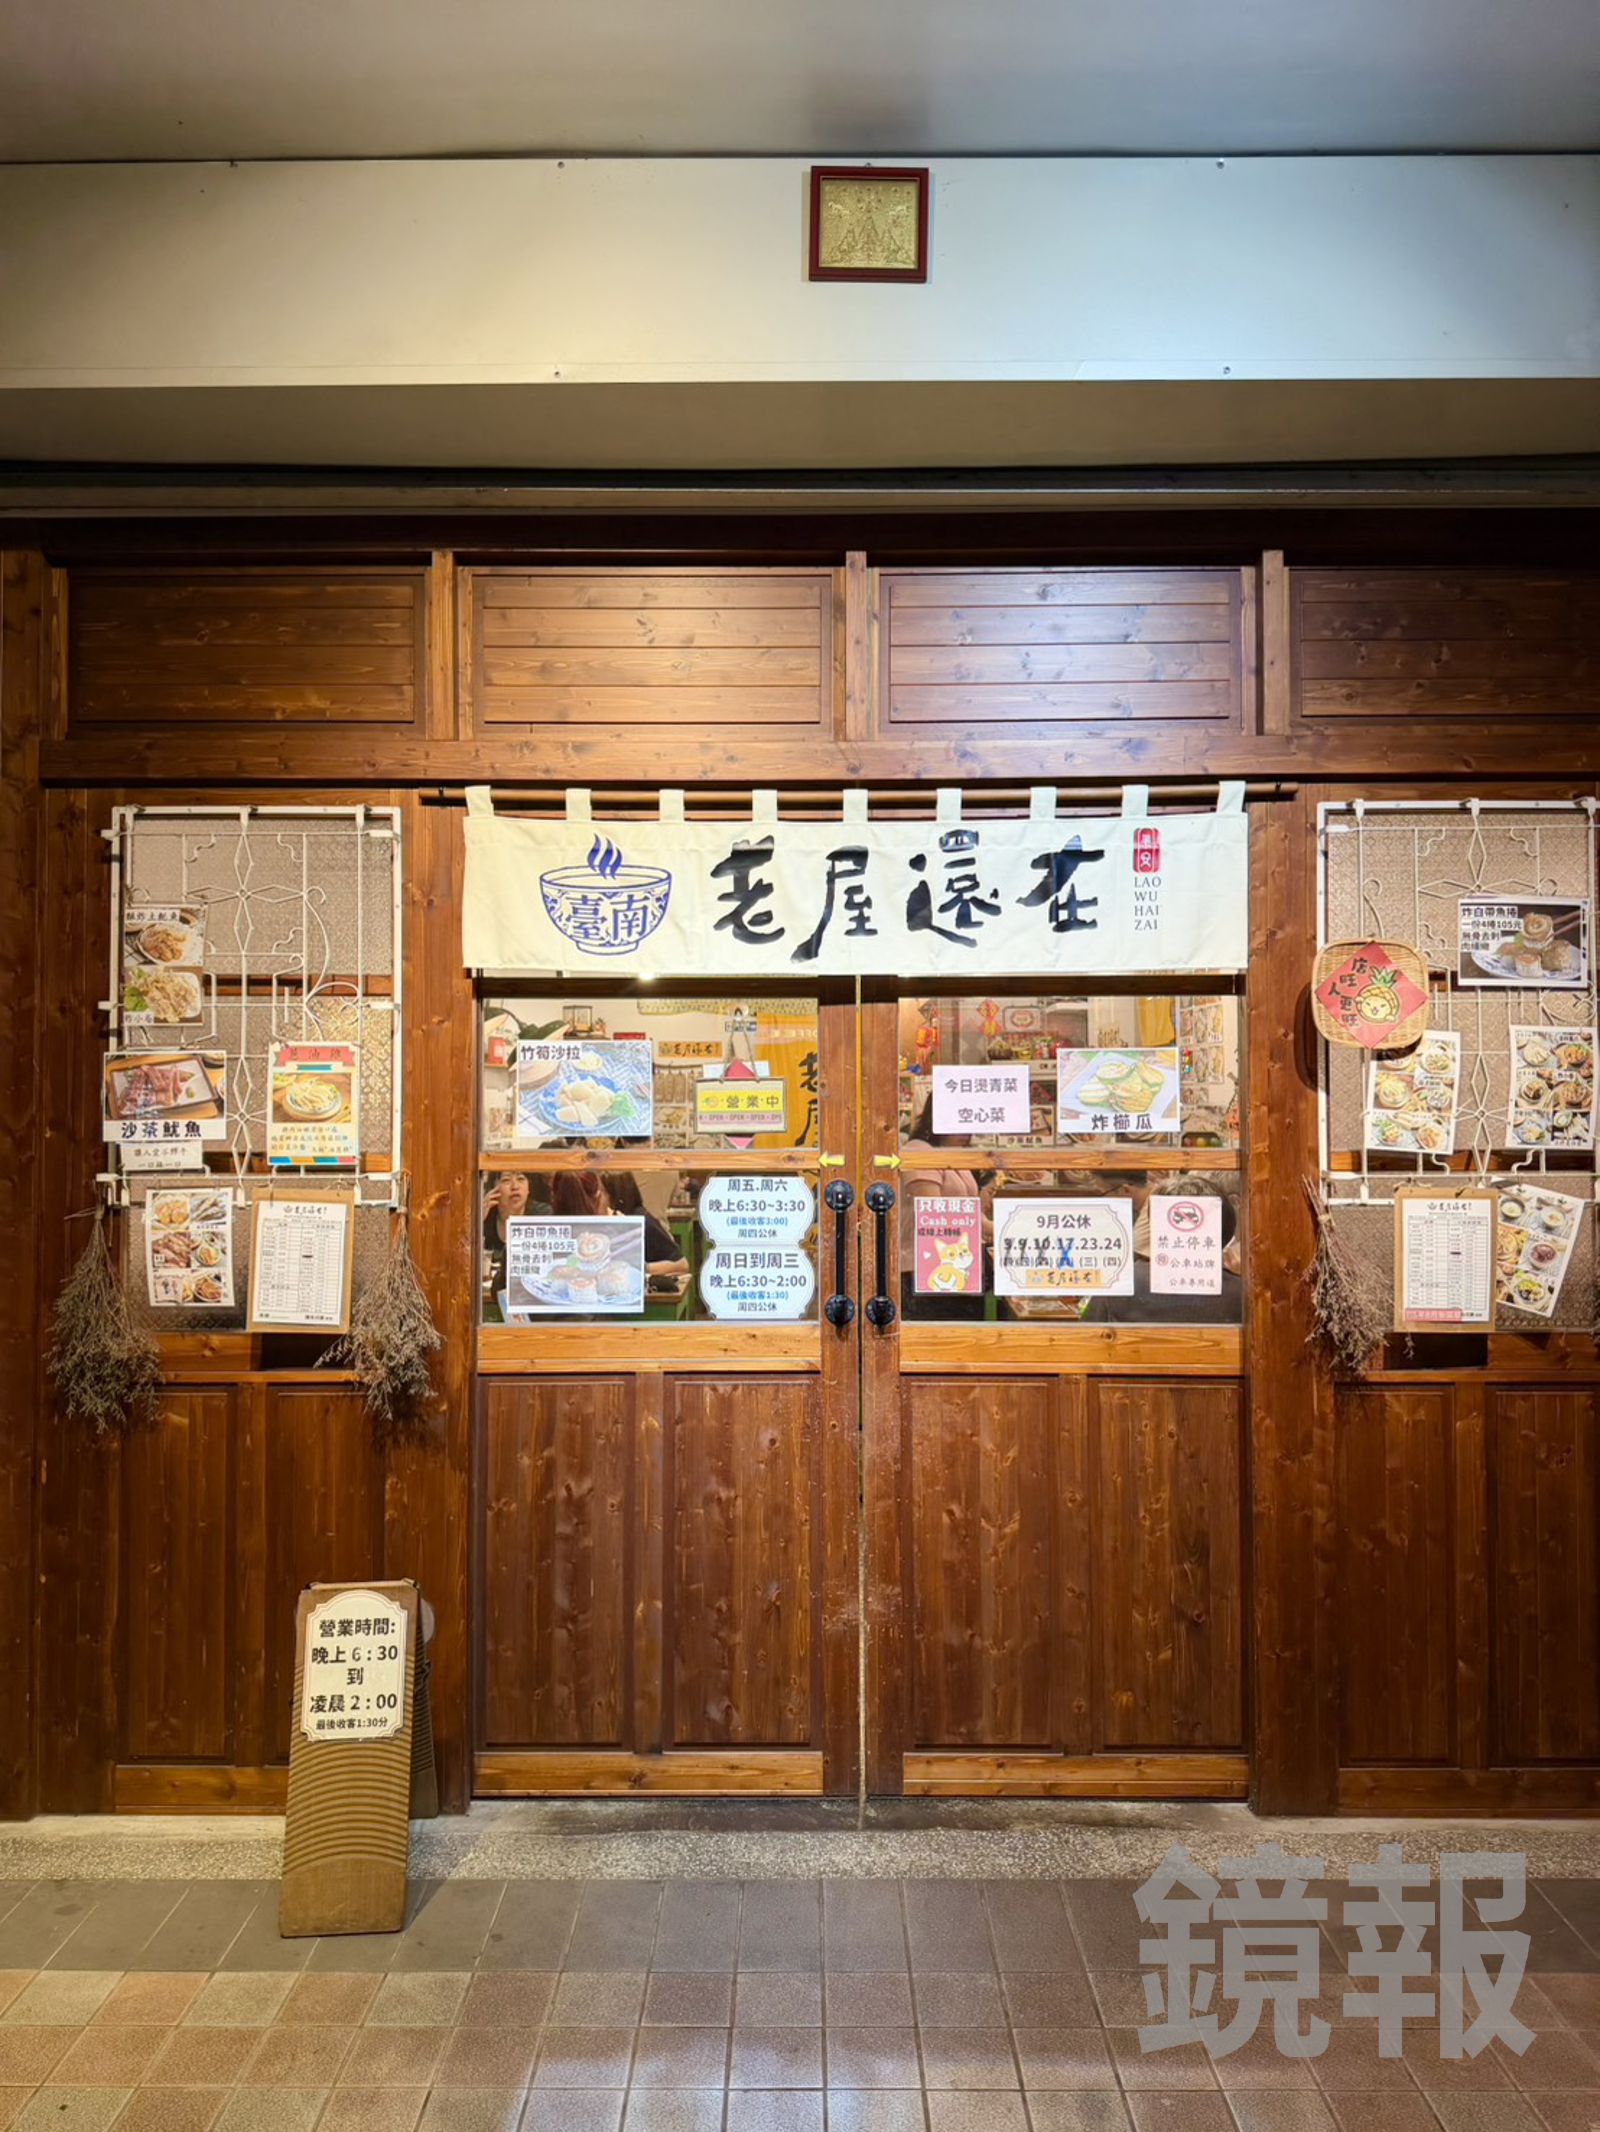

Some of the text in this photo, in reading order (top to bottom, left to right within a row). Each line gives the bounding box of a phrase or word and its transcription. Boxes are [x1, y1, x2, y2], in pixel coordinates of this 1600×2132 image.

[1134, 876, 1162, 888] LAO
[711, 829, 1105, 964] 老屋還在
[1134, 891, 1158, 902] WU
[565, 894, 649, 942] 臺南
[1134, 905, 1160, 916] HAI
[1134, 919, 1159, 931] ZAI
[521, 1044, 581, 1060] 竹筍沙拉
[945, 1078, 1018, 1093] 今日燙青菜
[958, 1107, 1006, 1123] 空心菜
[1092, 1113, 1152, 1130] 炸櫛瓜
[121, 1121, 202, 1139] 沙茶魷魚
[728, 1179, 788, 1192] 周五.周六
[708, 1198, 806, 1213] 晚上6:30~3:30
[920, 1215, 976, 1227] Cash only
[1036, 1214, 1092, 1229] 9月公休
[738, 1228, 778, 1239] 周四公休
[1158, 1235, 1216, 1250] 禁止停車
[715, 1252, 800, 1269] 周日到周三
[709, 1274, 807, 1289] 晚上6:30~2:00
[737, 1302, 778, 1312] 周四公休
[319, 1617, 396, 1638] 營業時間:
[347, 1667, 364, 1685] 到
[316, 1718, 388, 1730] 最後收客1:30分
